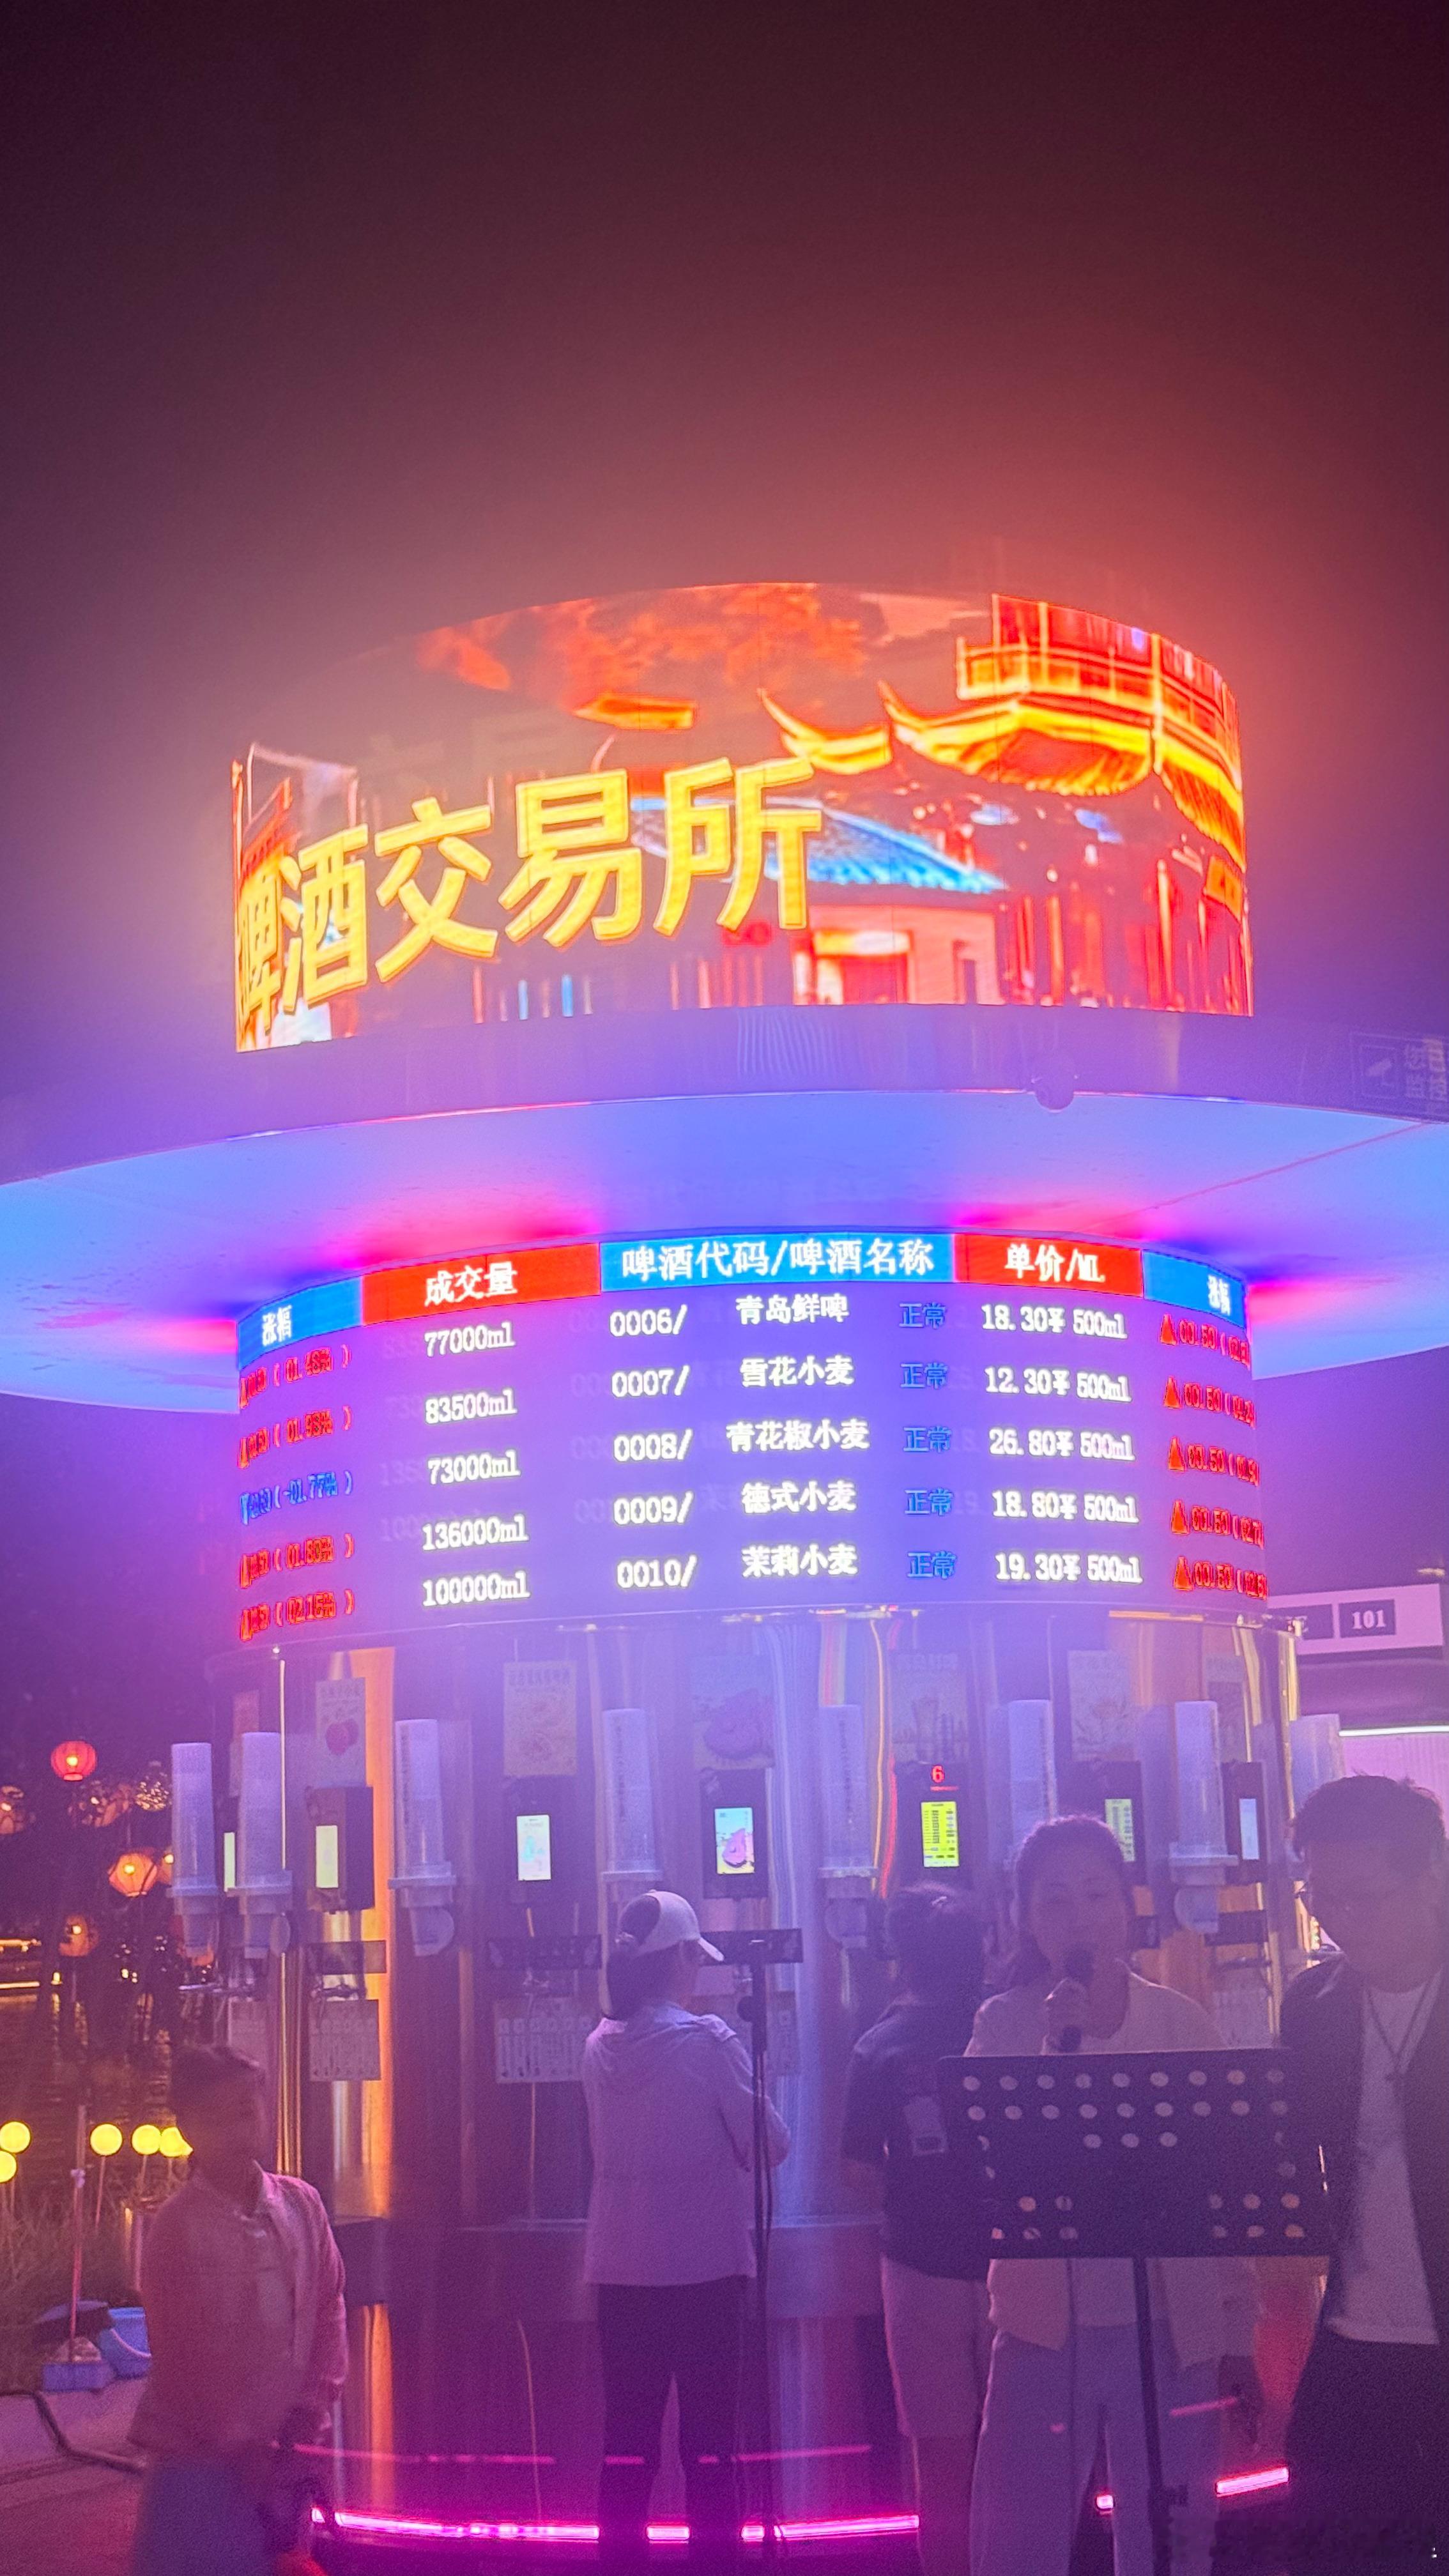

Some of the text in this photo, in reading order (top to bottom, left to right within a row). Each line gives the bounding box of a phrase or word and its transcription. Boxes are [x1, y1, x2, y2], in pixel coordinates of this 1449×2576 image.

[237, 757, 822, 1034] 啤酒交易所
[424, 1261, 518, 1307] 成交量
[622, 1238, 935, 1282] 啤酒代码/啤酒名称
[424, 1322, 516, 1357] 77000ml
[610, 1305, 687, 1337] 0006/
[736, 1292, 849, 1325] 青岛鲜啤
[899, 1302, 946, 1329] 正常
[1073, 1309, 1128, 1338] 500ml
[425, 1388, 518, 1424] 83500ml
[611, 1365, 690, 1398] 0007/
[740, 1354, 855, 1387] 雪花小麦
[900, 1362, 948, 1389] 正常
[1077, 1372, 1132, 1402] 500ml
[427, 1449, 521, 1485] 73000ml
[614, 1429, 693, 1462] 0008/
[726, 1418, 870, 1452] 青花椒小麦
[903, 1425, 952, 1453] 正常
[1080, 1432, 1135, 1460] 500ml
[422, 1514, 529, 1551] 136000ml
[614, 1491, 693, 1525] 0009/
[742, 1480, 857, 1514] 德式小麦
[905, 1487, 954, 1515] 正常
[1084, 1494, 1139, 1523] 500ml
[423, 1570, 530, 1606] 100000ml
[617, 1554, 697, 1588] 0010/
[742, 1543, 858, 1577] 茉莉小麦
[907, 1551, 957, 1579] 正常
[1087, 1554, 1143, 1583] 500ml
[1351, 1609, 1386, 1629] 101
[931, 1765, 945, 1783] 6
